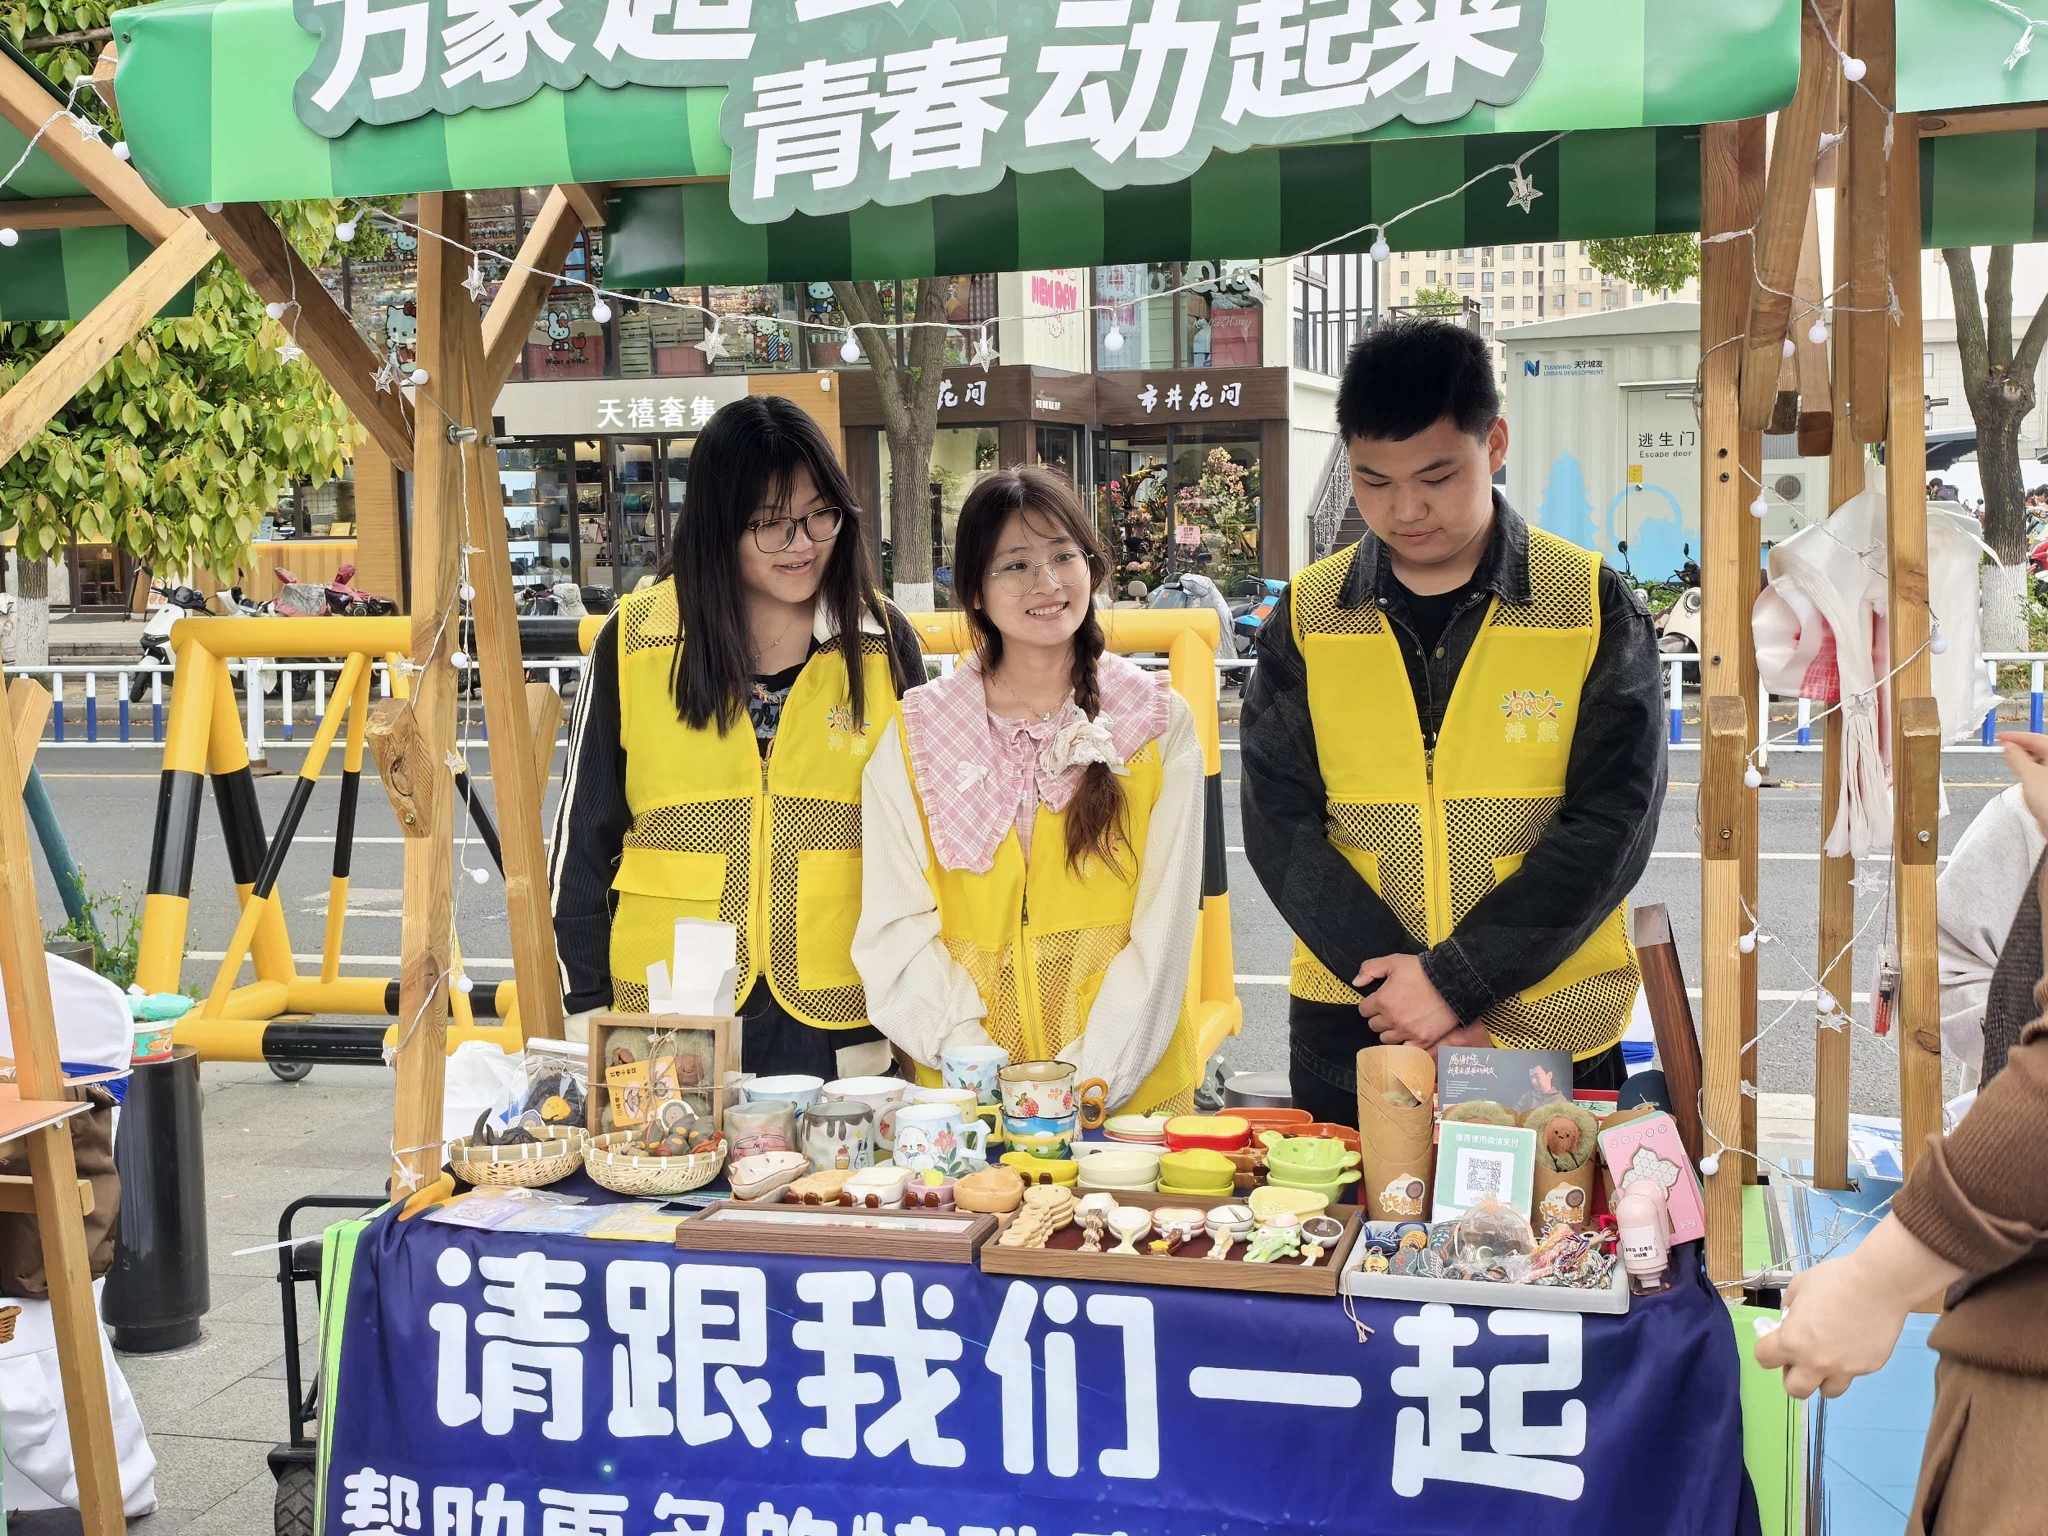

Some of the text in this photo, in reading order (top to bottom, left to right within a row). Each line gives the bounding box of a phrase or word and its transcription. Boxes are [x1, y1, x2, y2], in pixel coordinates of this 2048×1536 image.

[744, 0, 1521, 199] 青春动起来
[1055, 281, 1077, 311] DAY
[1574, 360, 1603, 369] 天宁城发
[597, 396, 716, 429] 天禧奢集
[1137, 381, 1242, 413] 市井花间
[1638, 431, 1695, 448] 逃生门
[428, 1250, 1587, 1501] 请跟我们一起
